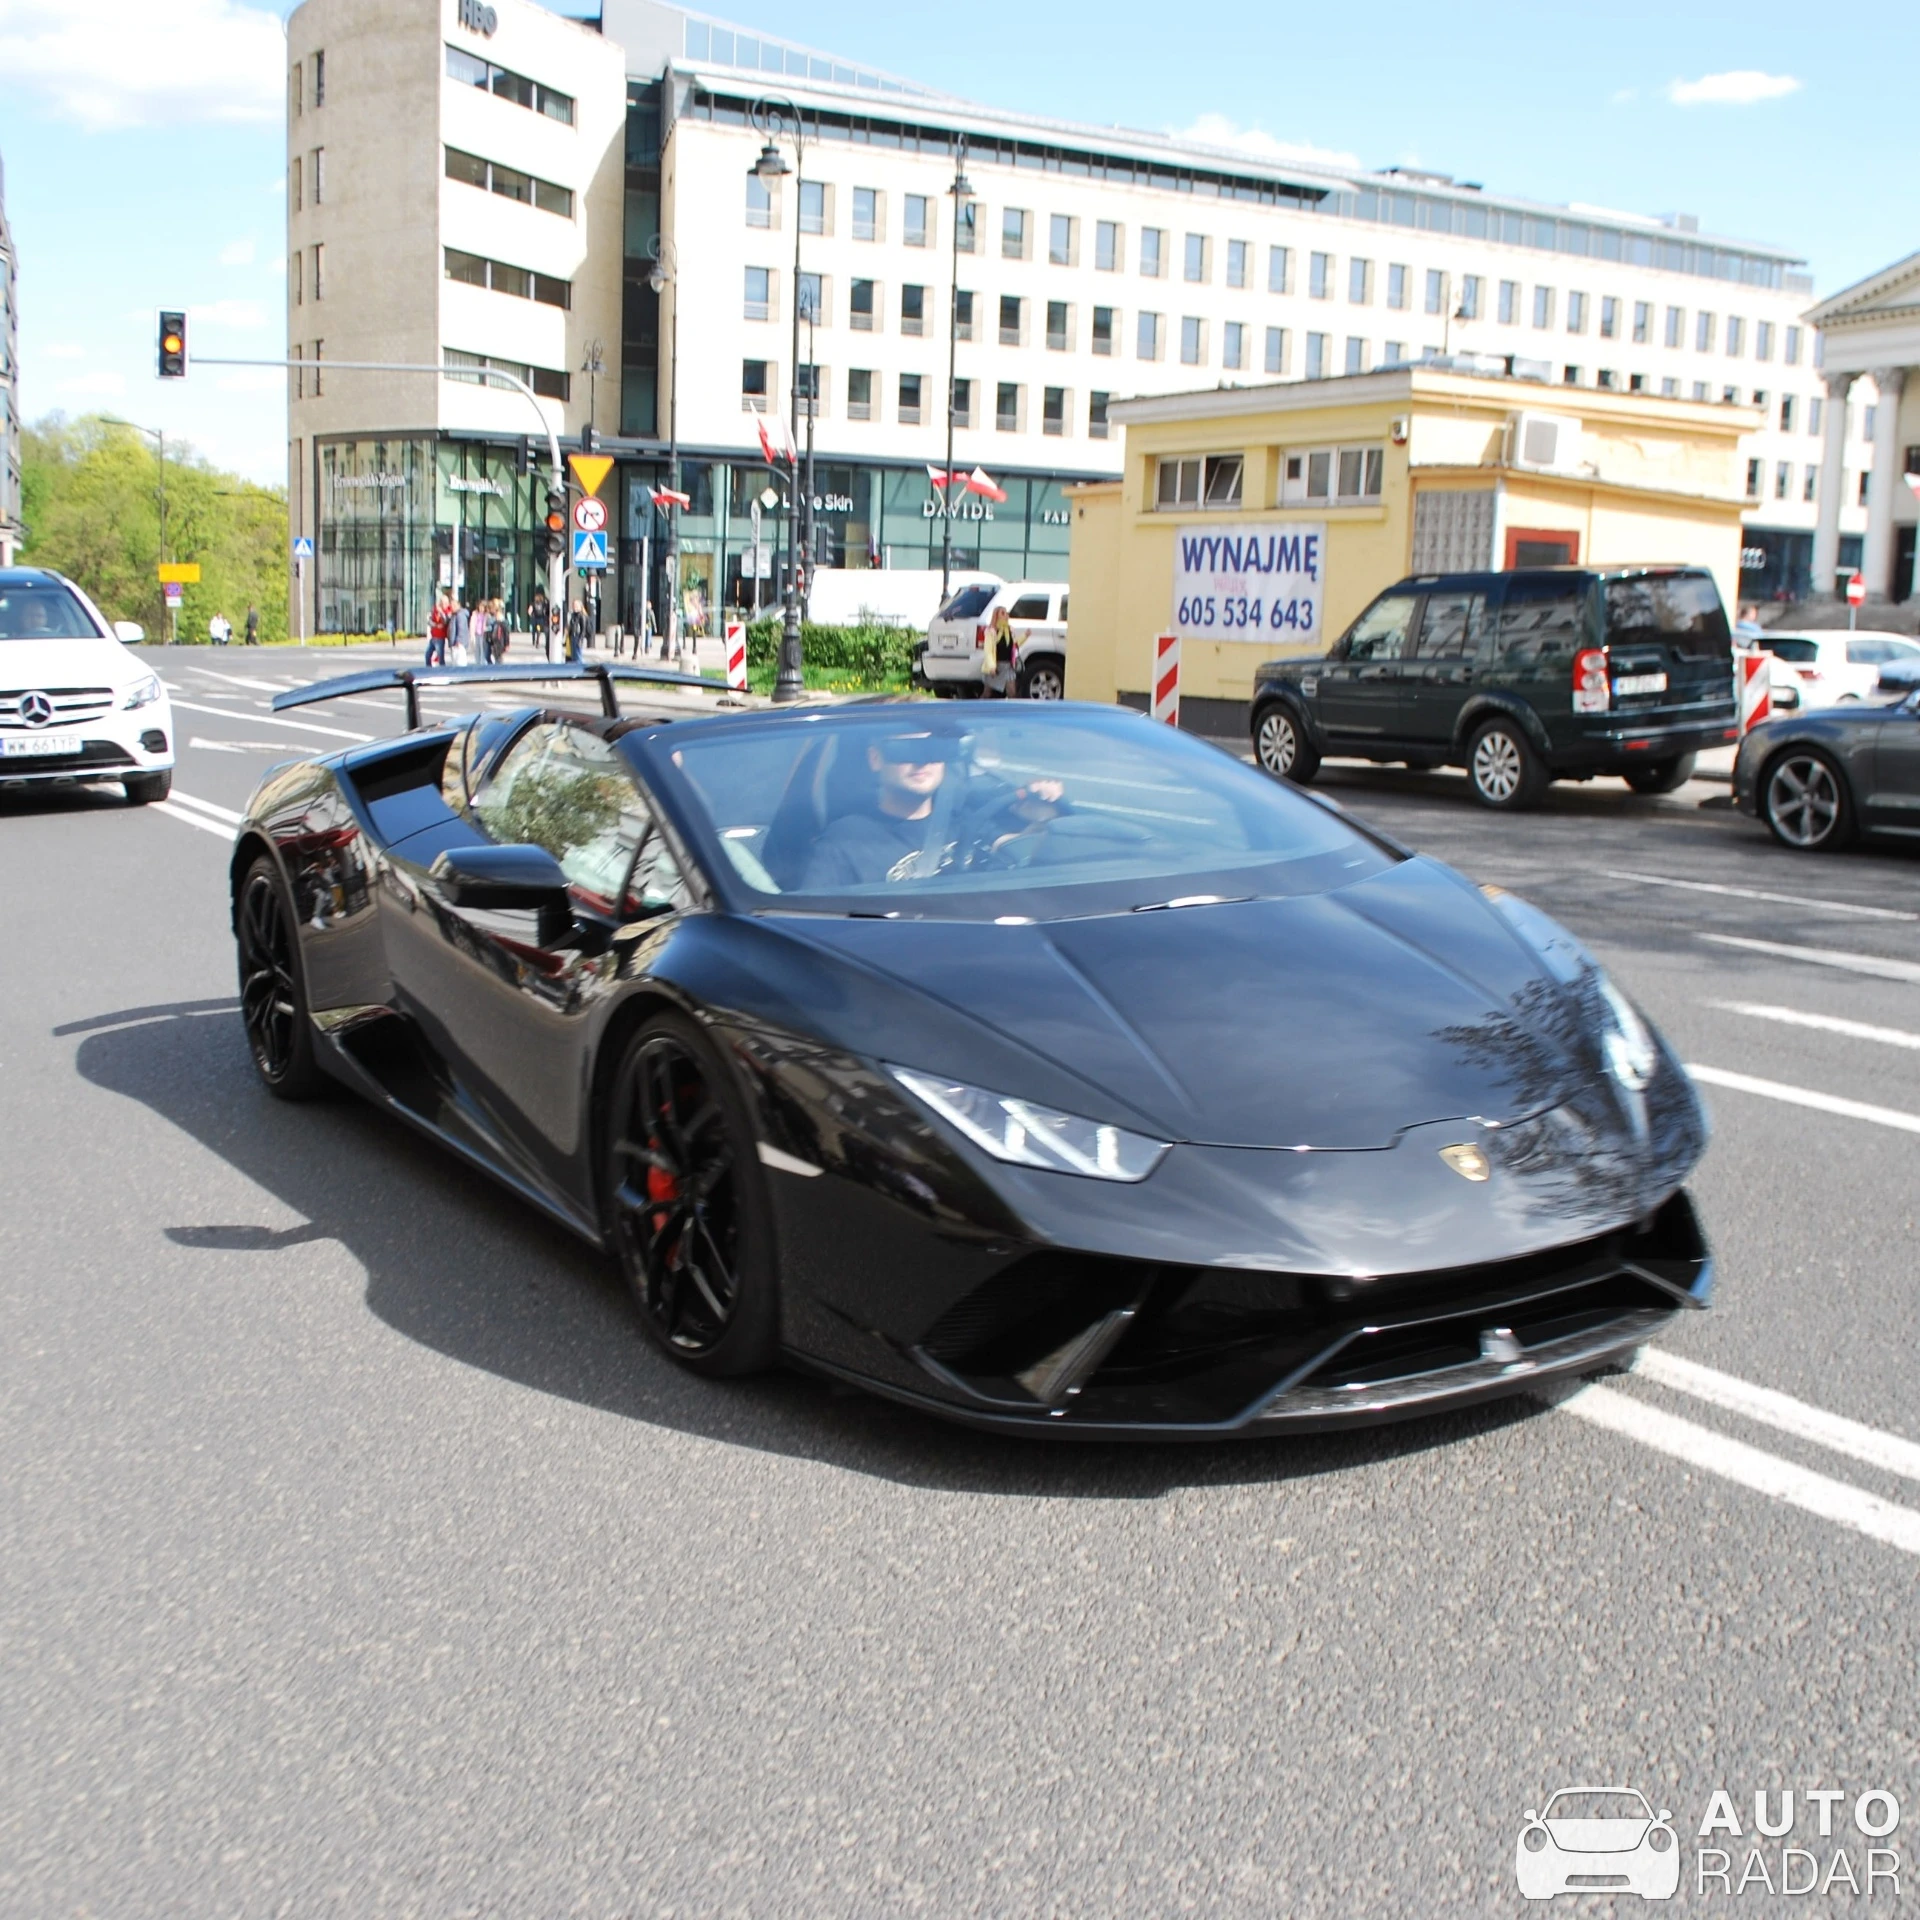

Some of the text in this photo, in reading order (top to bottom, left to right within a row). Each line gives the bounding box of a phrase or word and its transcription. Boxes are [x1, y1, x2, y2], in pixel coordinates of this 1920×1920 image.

[458, 0, 498, 38] HBO
[824, 493, 853, 512] Skin
[923, 499, 994, 521] DAVIDE
[1182, 535, 1318, 582] WYNAJMĘ
[1178, 597, 1313, 630] 605 534 643
